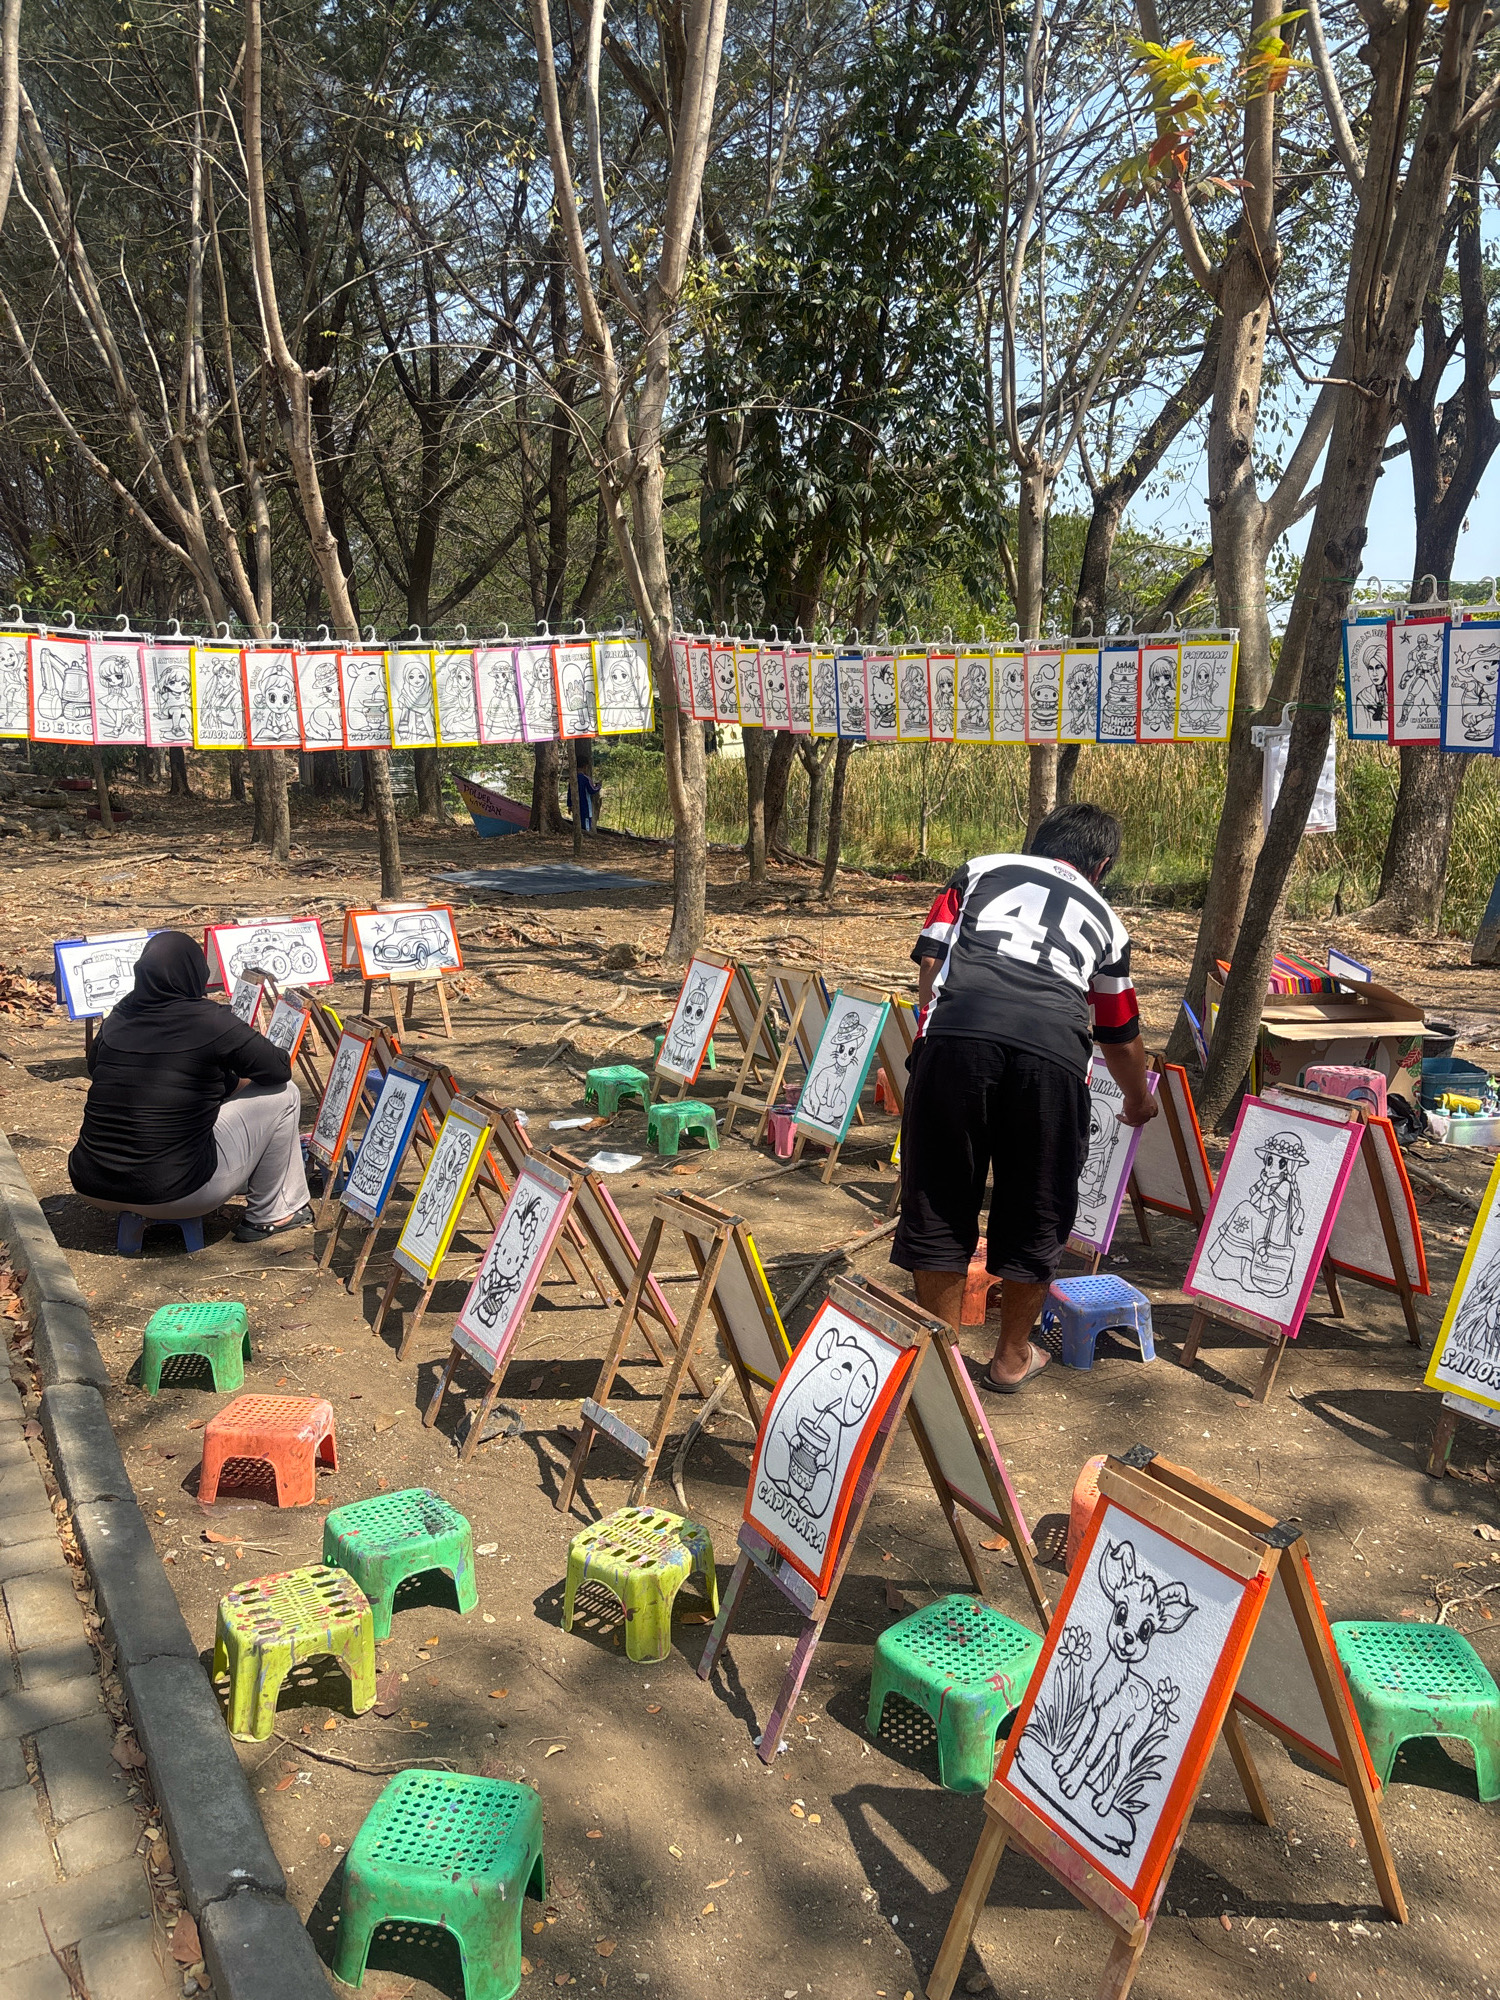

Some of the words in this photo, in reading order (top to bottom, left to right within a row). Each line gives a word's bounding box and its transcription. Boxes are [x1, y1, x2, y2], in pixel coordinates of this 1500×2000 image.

[1183, 650, 1229, 660] FATIMAH
[37, 720, 94, 735] BEKO
[1110, 716, 1137, 728] HAPPY
[199, 729, 228, 740] SAILOR
[976, 881, 1112, 992] 45
[352, 1166, 382, 1196] BIRTHDAY
[362, 1160, 382, 1183] HAPPY
[1439, 1348, 1500, 1390] SAILOR
[758, 1480, 827, 1554] CAPYBARA
